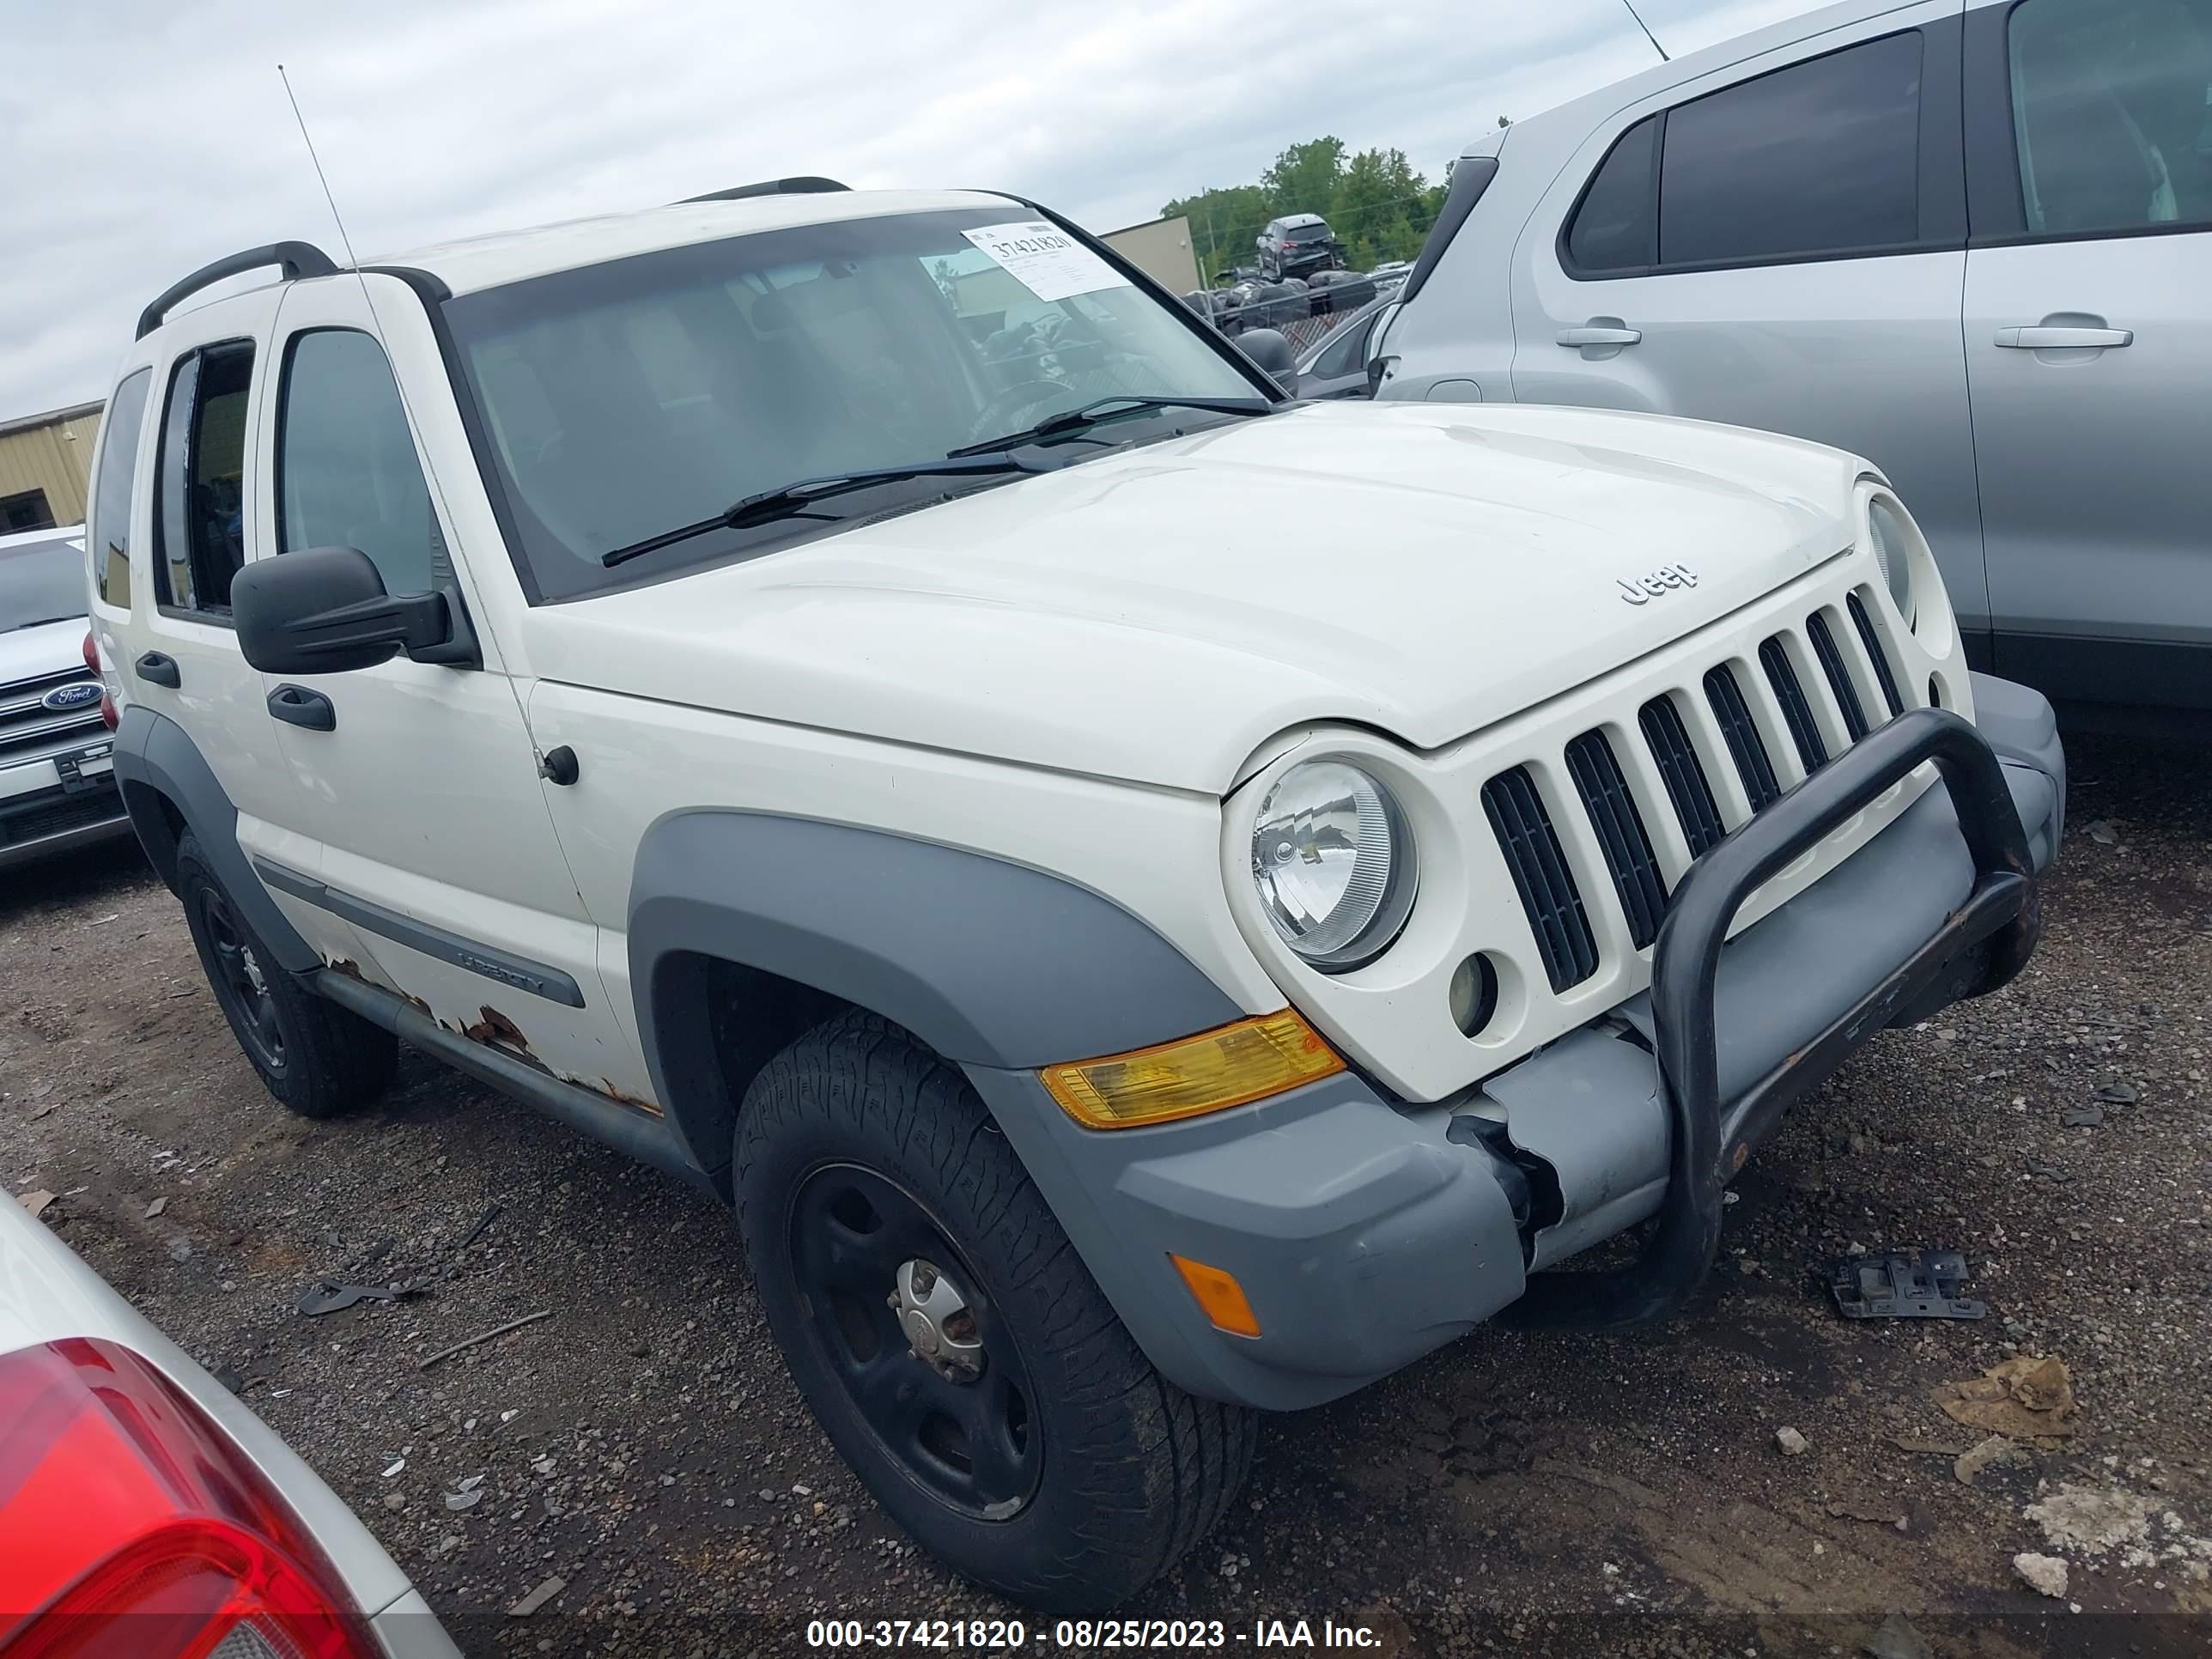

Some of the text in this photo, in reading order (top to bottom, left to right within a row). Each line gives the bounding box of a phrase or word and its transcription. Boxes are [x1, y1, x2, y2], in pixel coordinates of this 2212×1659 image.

[992, 234, 1072, 258] 37421820
[1615, 562, 1698, 605] Jeep
[58, 687, 91, 704] Ford
